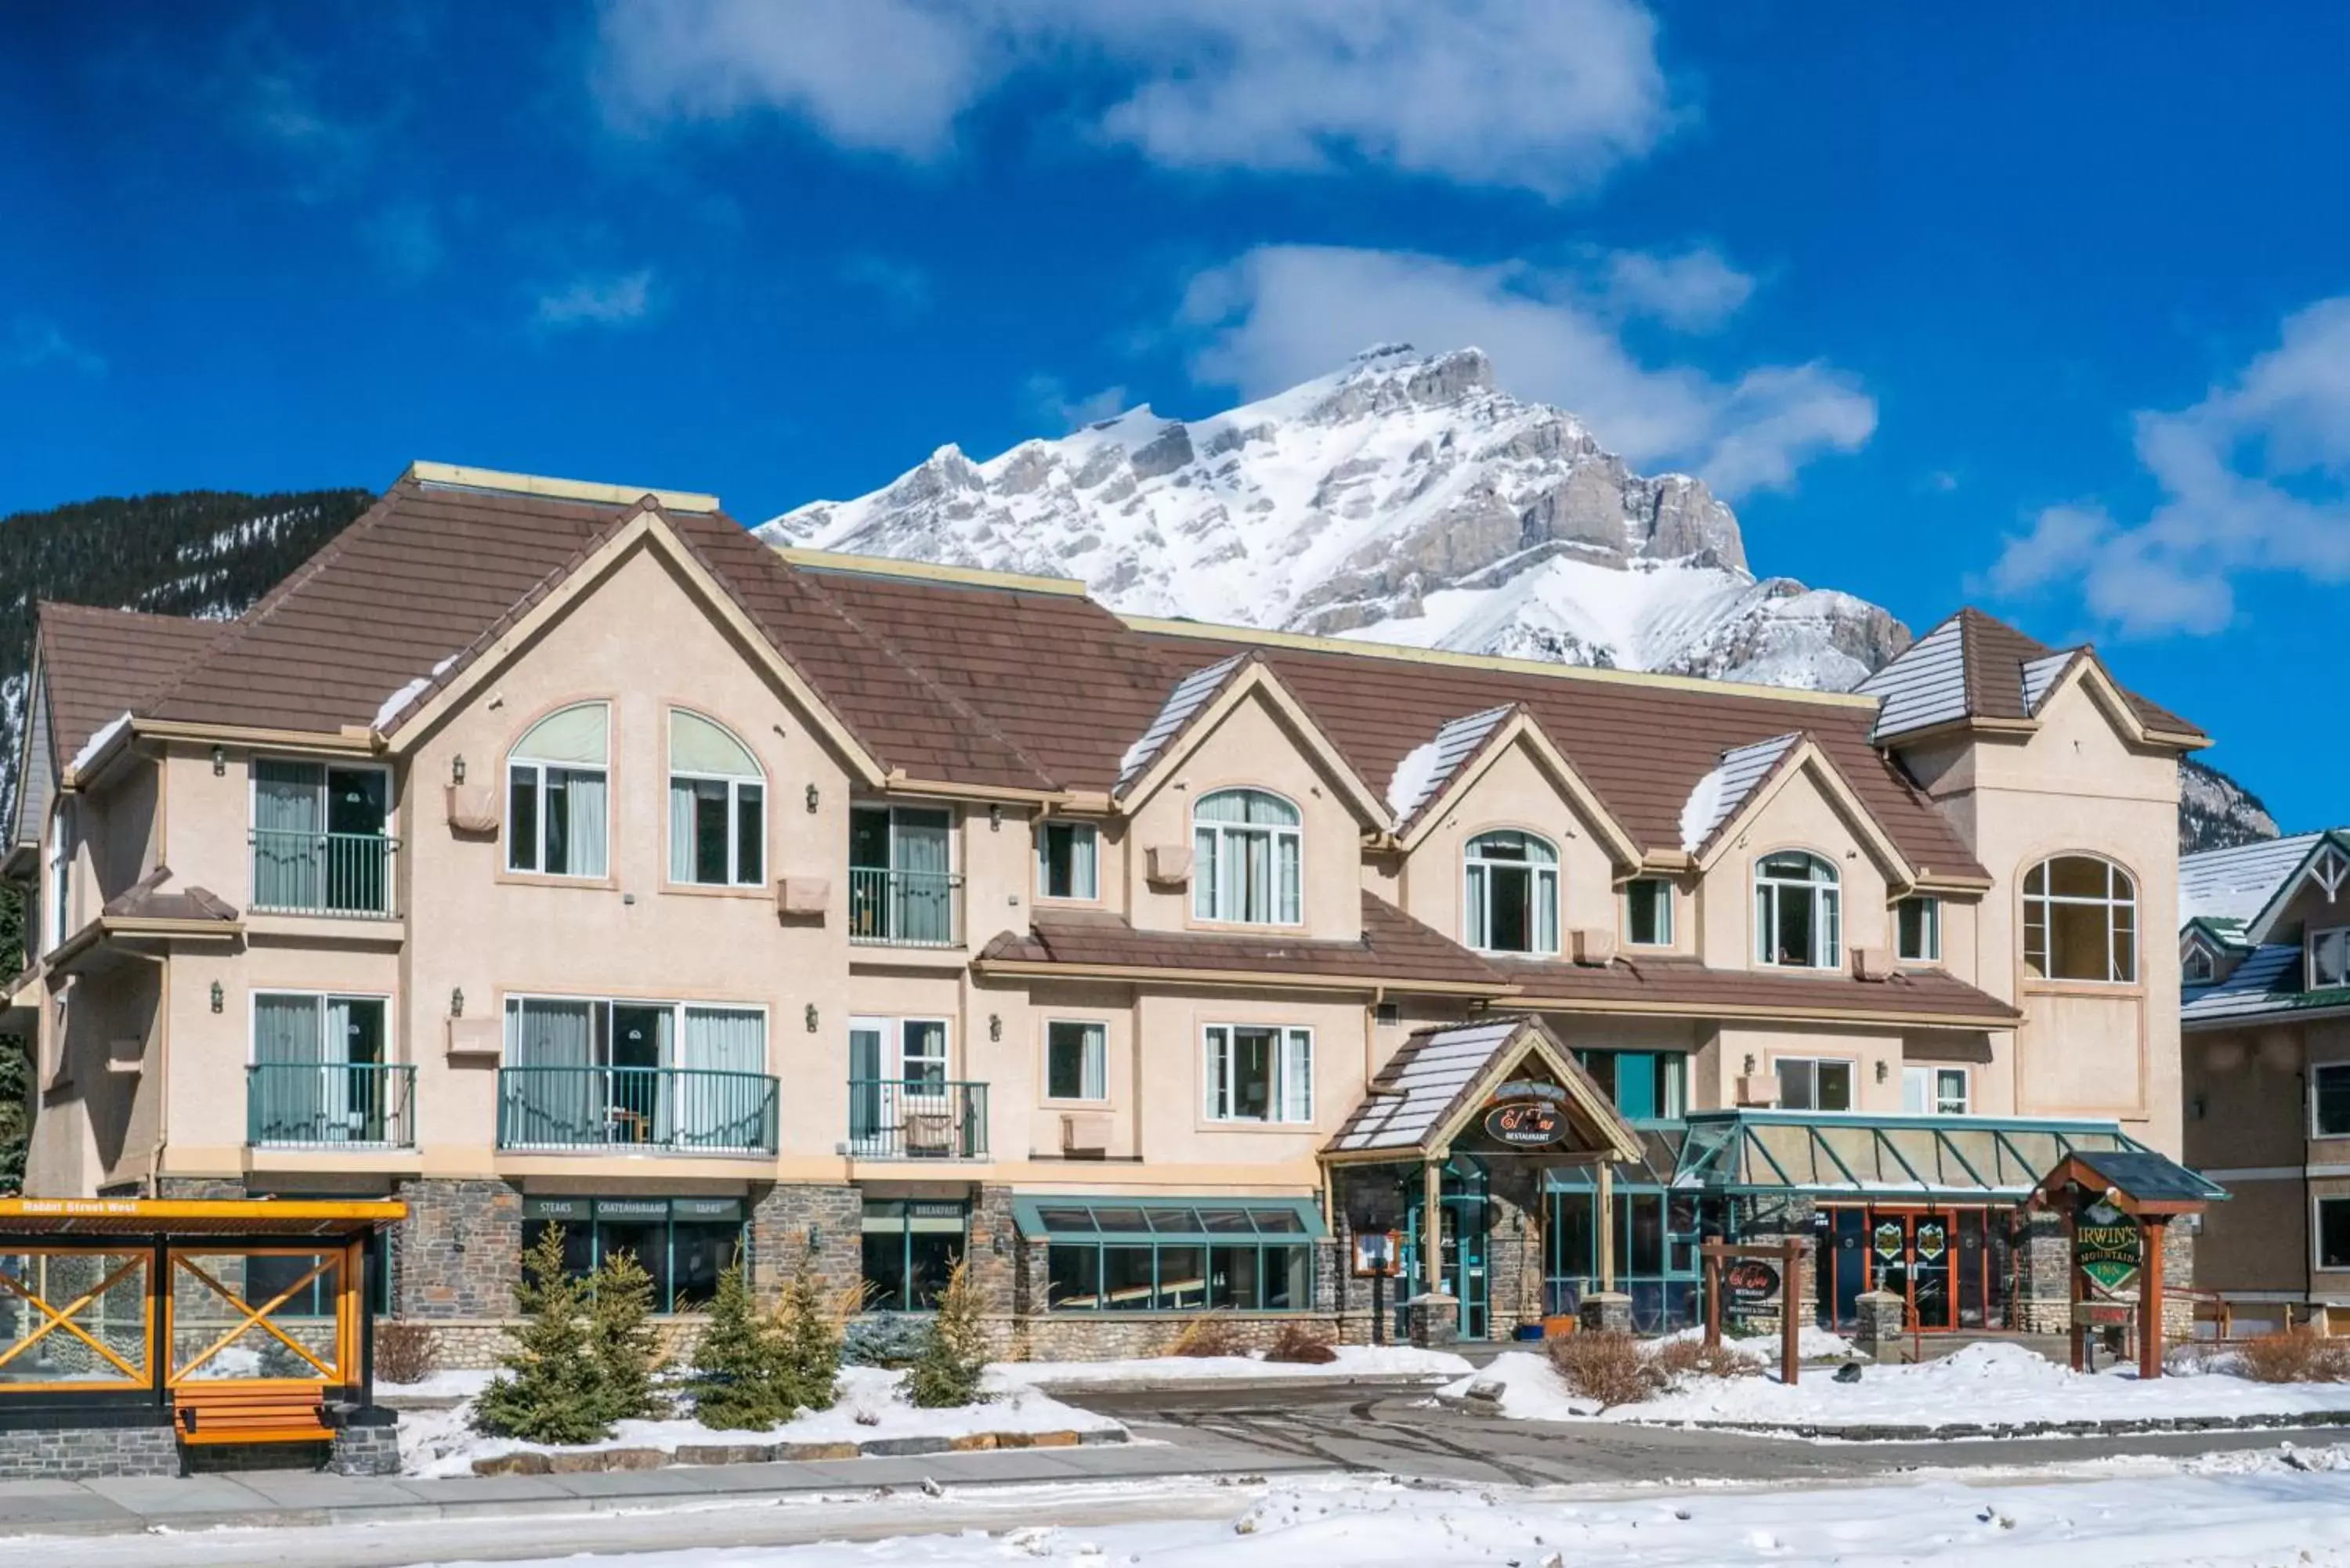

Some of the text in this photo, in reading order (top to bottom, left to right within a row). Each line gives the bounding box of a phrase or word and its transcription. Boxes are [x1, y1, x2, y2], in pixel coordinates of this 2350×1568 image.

[1505, 1132, 1549, 1141] RESTAURANT
[24, 1201, 136, 1212] Rabbit Street West
[540, 1202, 572, 1213] STEAKS
[2077, 1226, 2138, 1244] IRWIN'S
[2081, 1250, 2135, 1263] MOUNTAIN
[2097, 1265, 2121, 1277] INN
